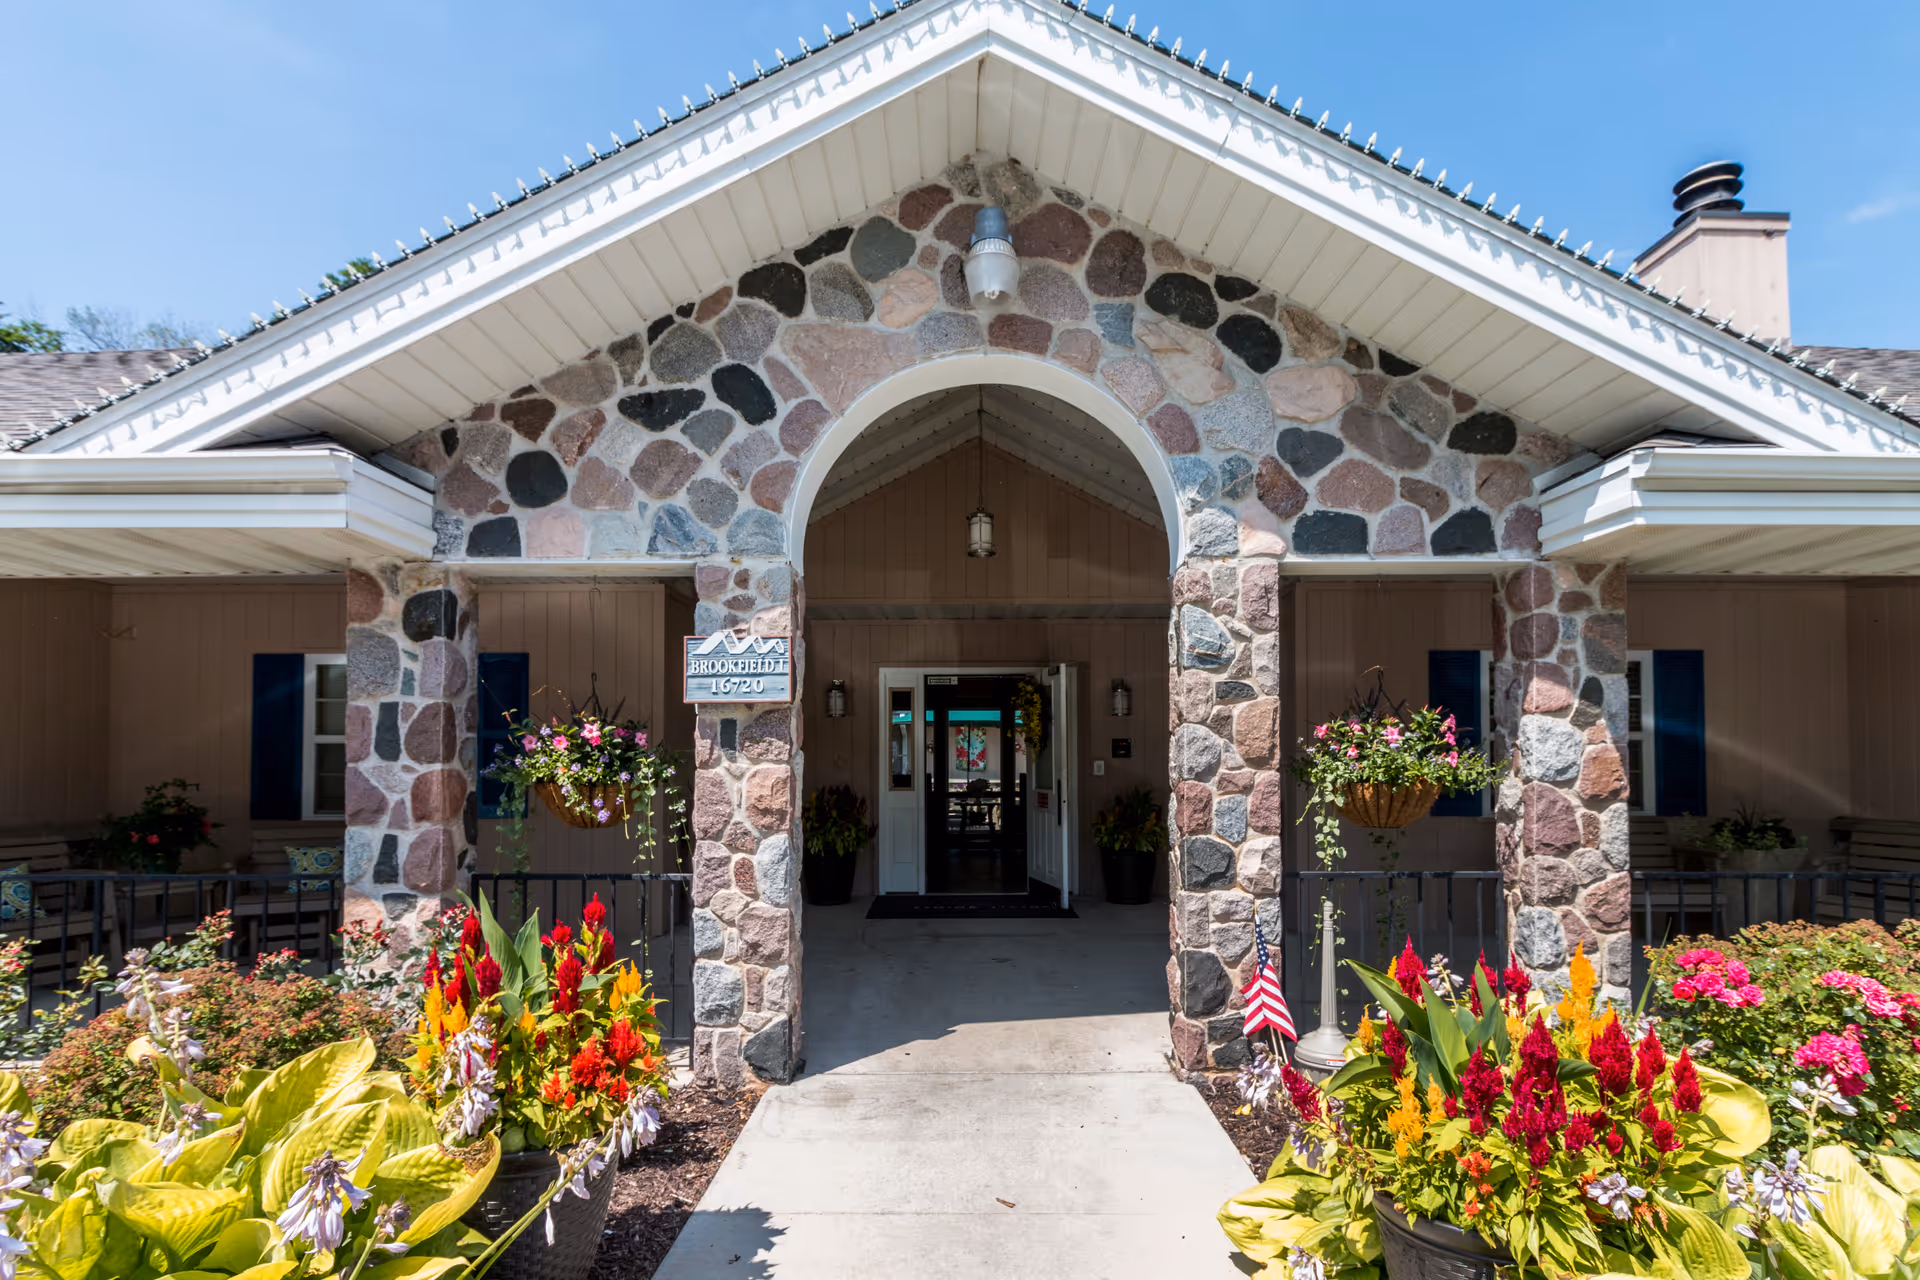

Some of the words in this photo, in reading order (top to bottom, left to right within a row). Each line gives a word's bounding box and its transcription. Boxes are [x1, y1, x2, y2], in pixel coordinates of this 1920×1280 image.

[691, 659, 775, 674] BROOKFIELD
[779, 658, 785, 672] I
[711, 677, 765, 694] 16720
